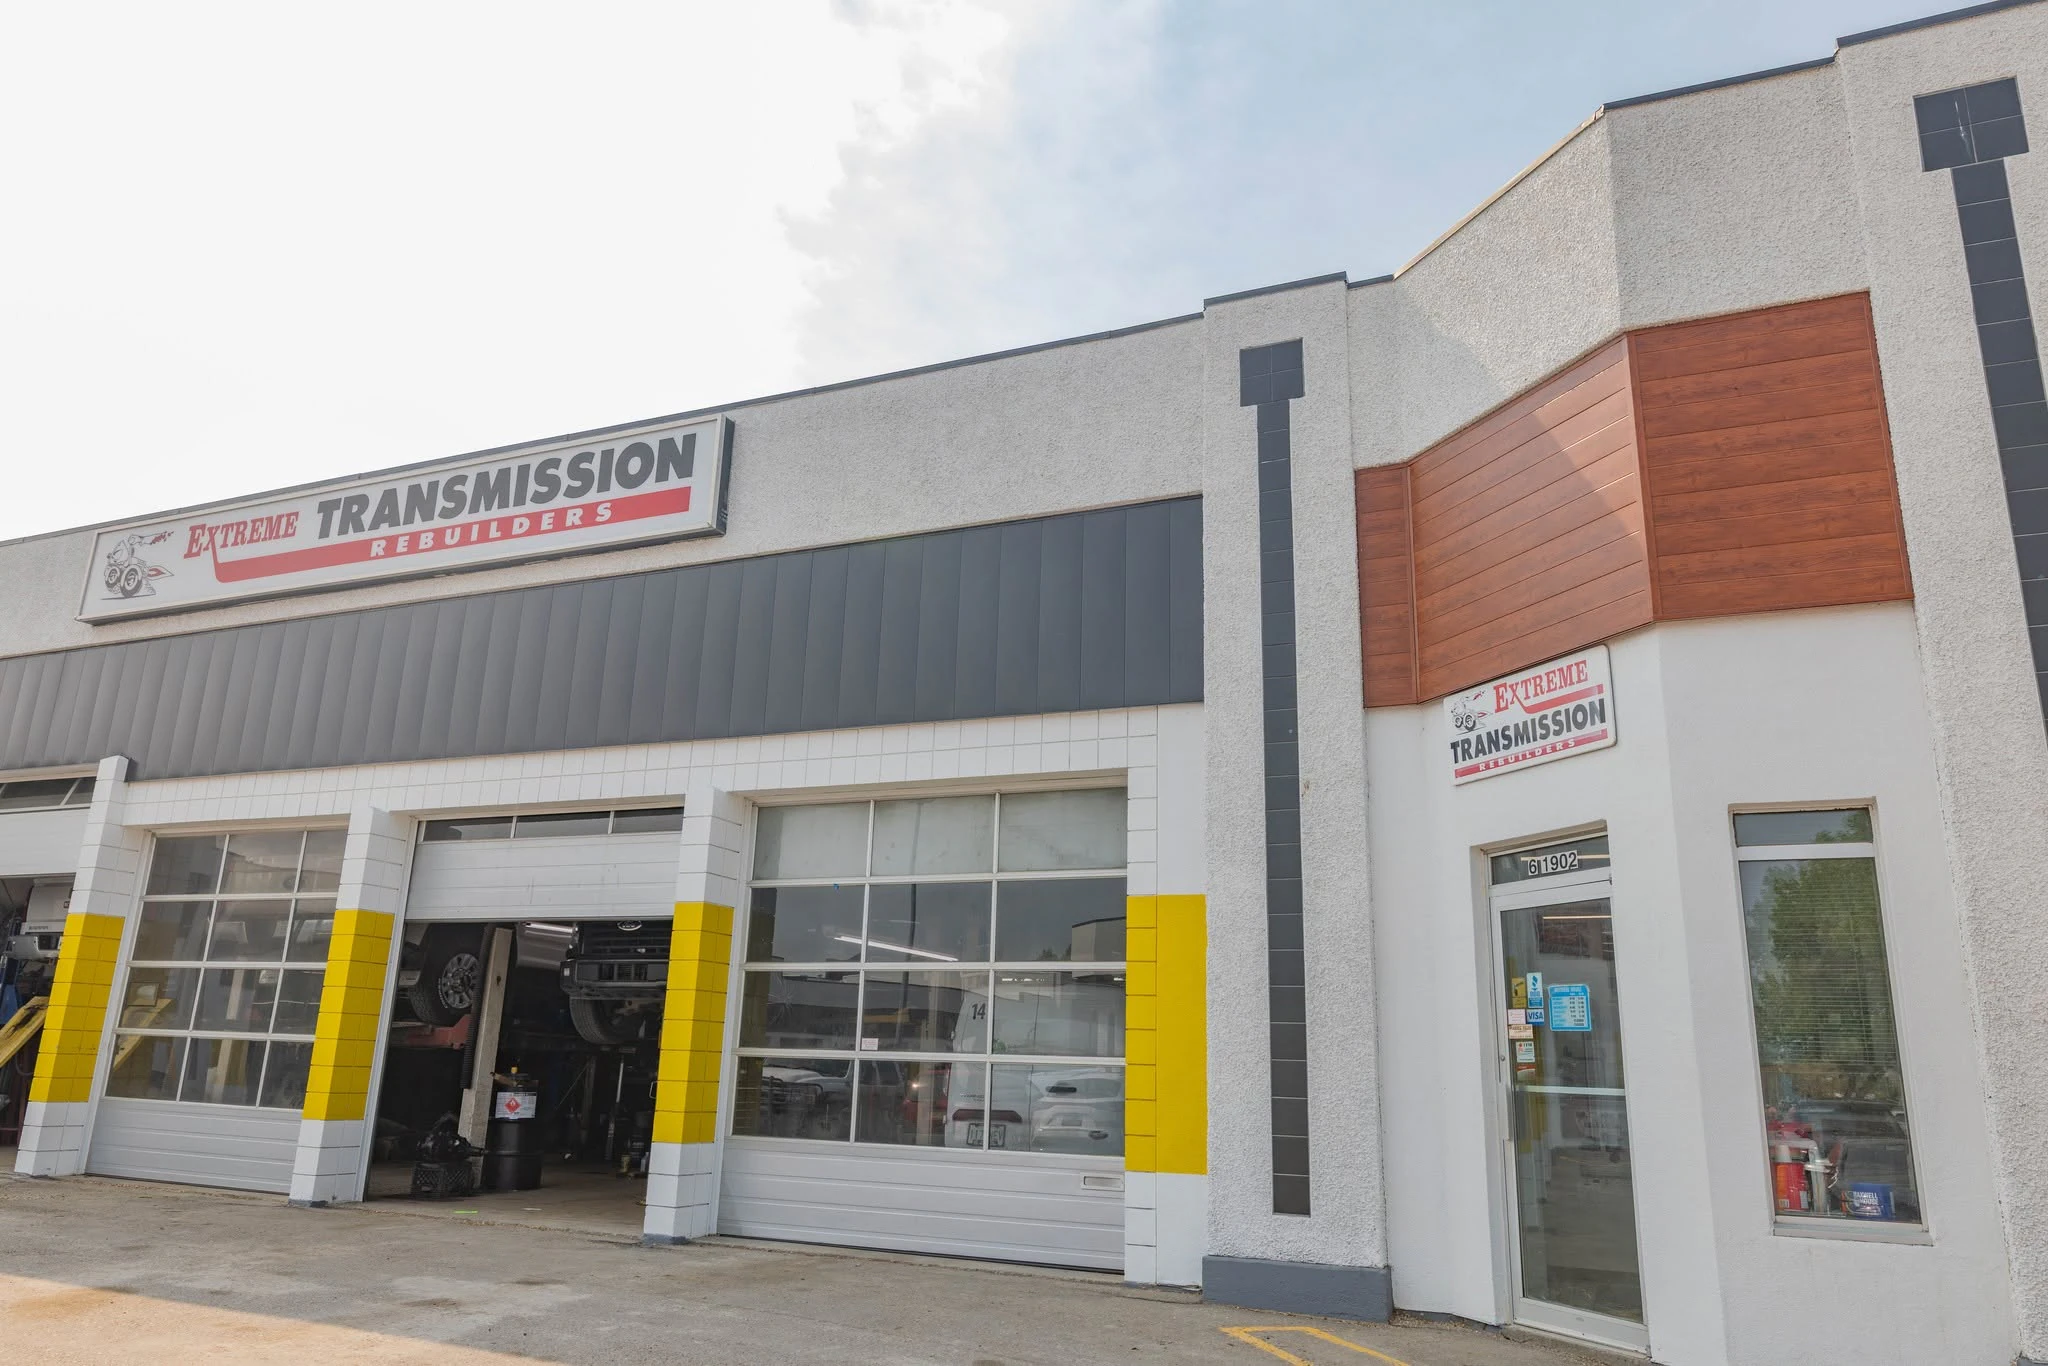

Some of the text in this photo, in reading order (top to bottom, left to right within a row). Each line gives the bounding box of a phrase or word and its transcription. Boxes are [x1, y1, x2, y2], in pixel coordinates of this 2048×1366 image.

[183, 433, 698, 560] EXTREME TRANSMISSION
[370, 502, 614, 558] REBUILDERS
[1493, 659, 1588, 713] EXTREME
[1450, 698, 1606, 764] TRANSMISSION
[1479, 739, 1576, 771] REBUILDERS
[971, 1003, 986, 1020] 14
[1528, 1011, 1544, 1020] VISA
